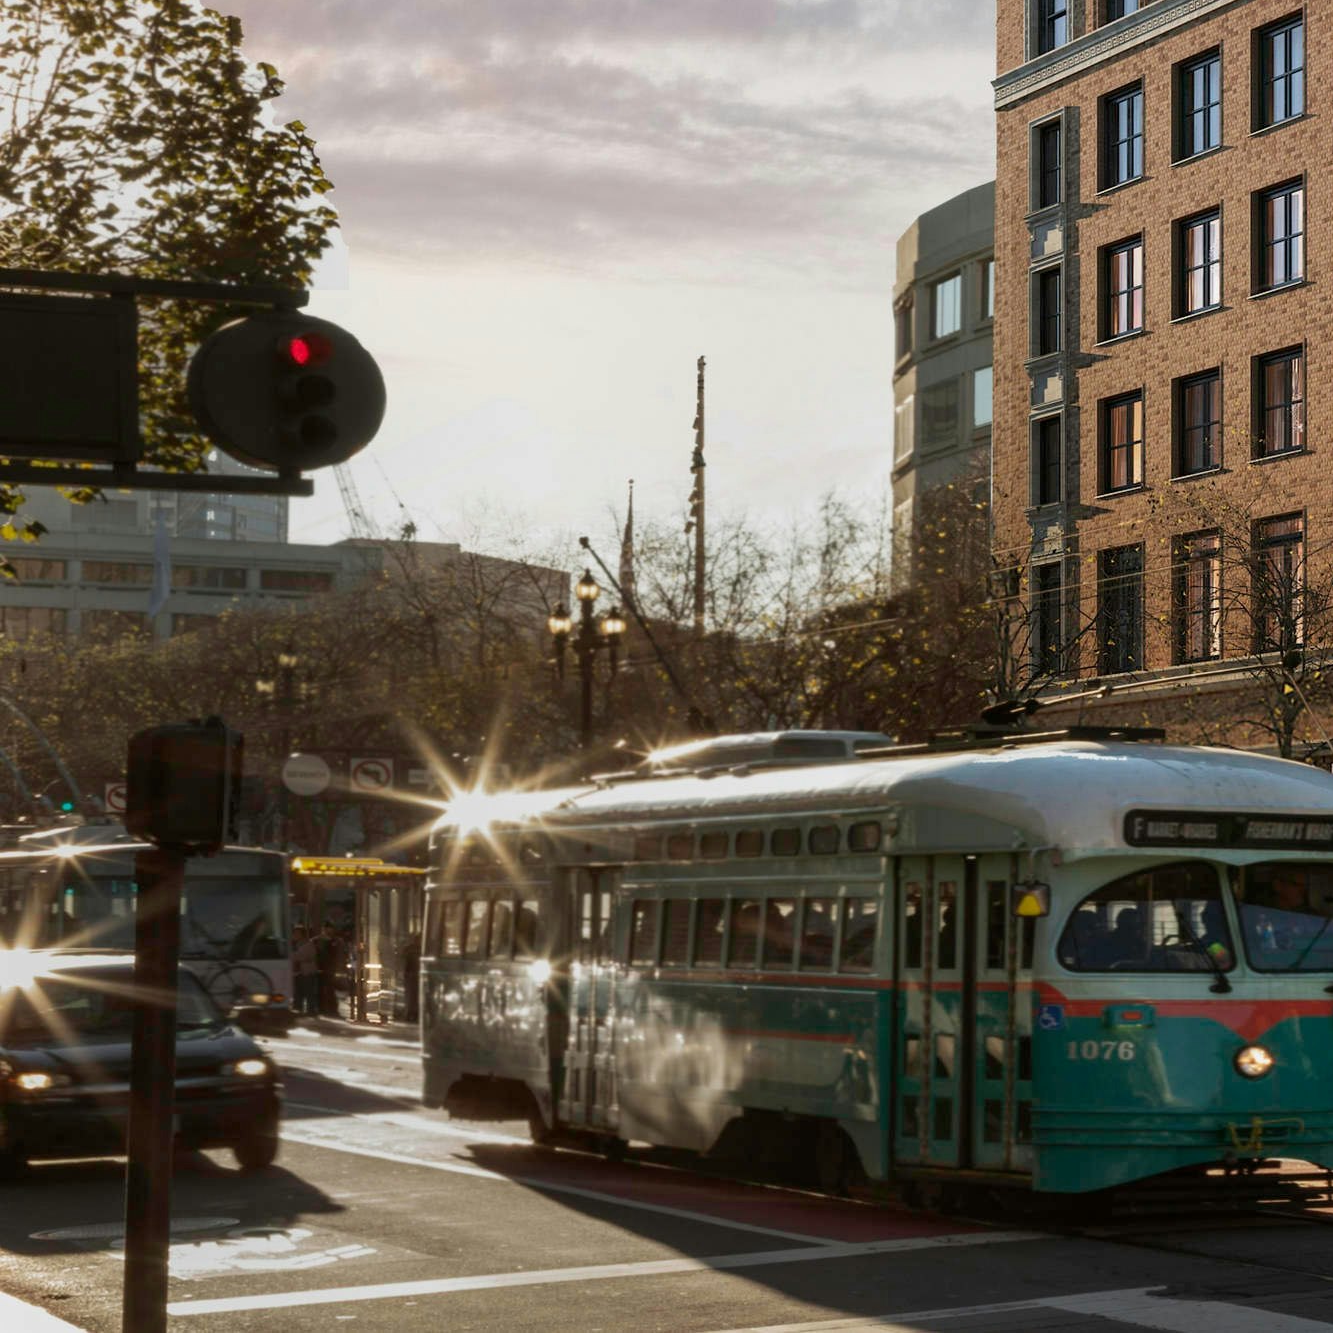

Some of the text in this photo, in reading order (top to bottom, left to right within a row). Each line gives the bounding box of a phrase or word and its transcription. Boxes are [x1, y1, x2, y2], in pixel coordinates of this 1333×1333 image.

[1133, 817, 1144, 839] F
[1245, 821, 1303, 840] FISHERMAN'S
[1066, 1040, 1136, 1061] 1076
